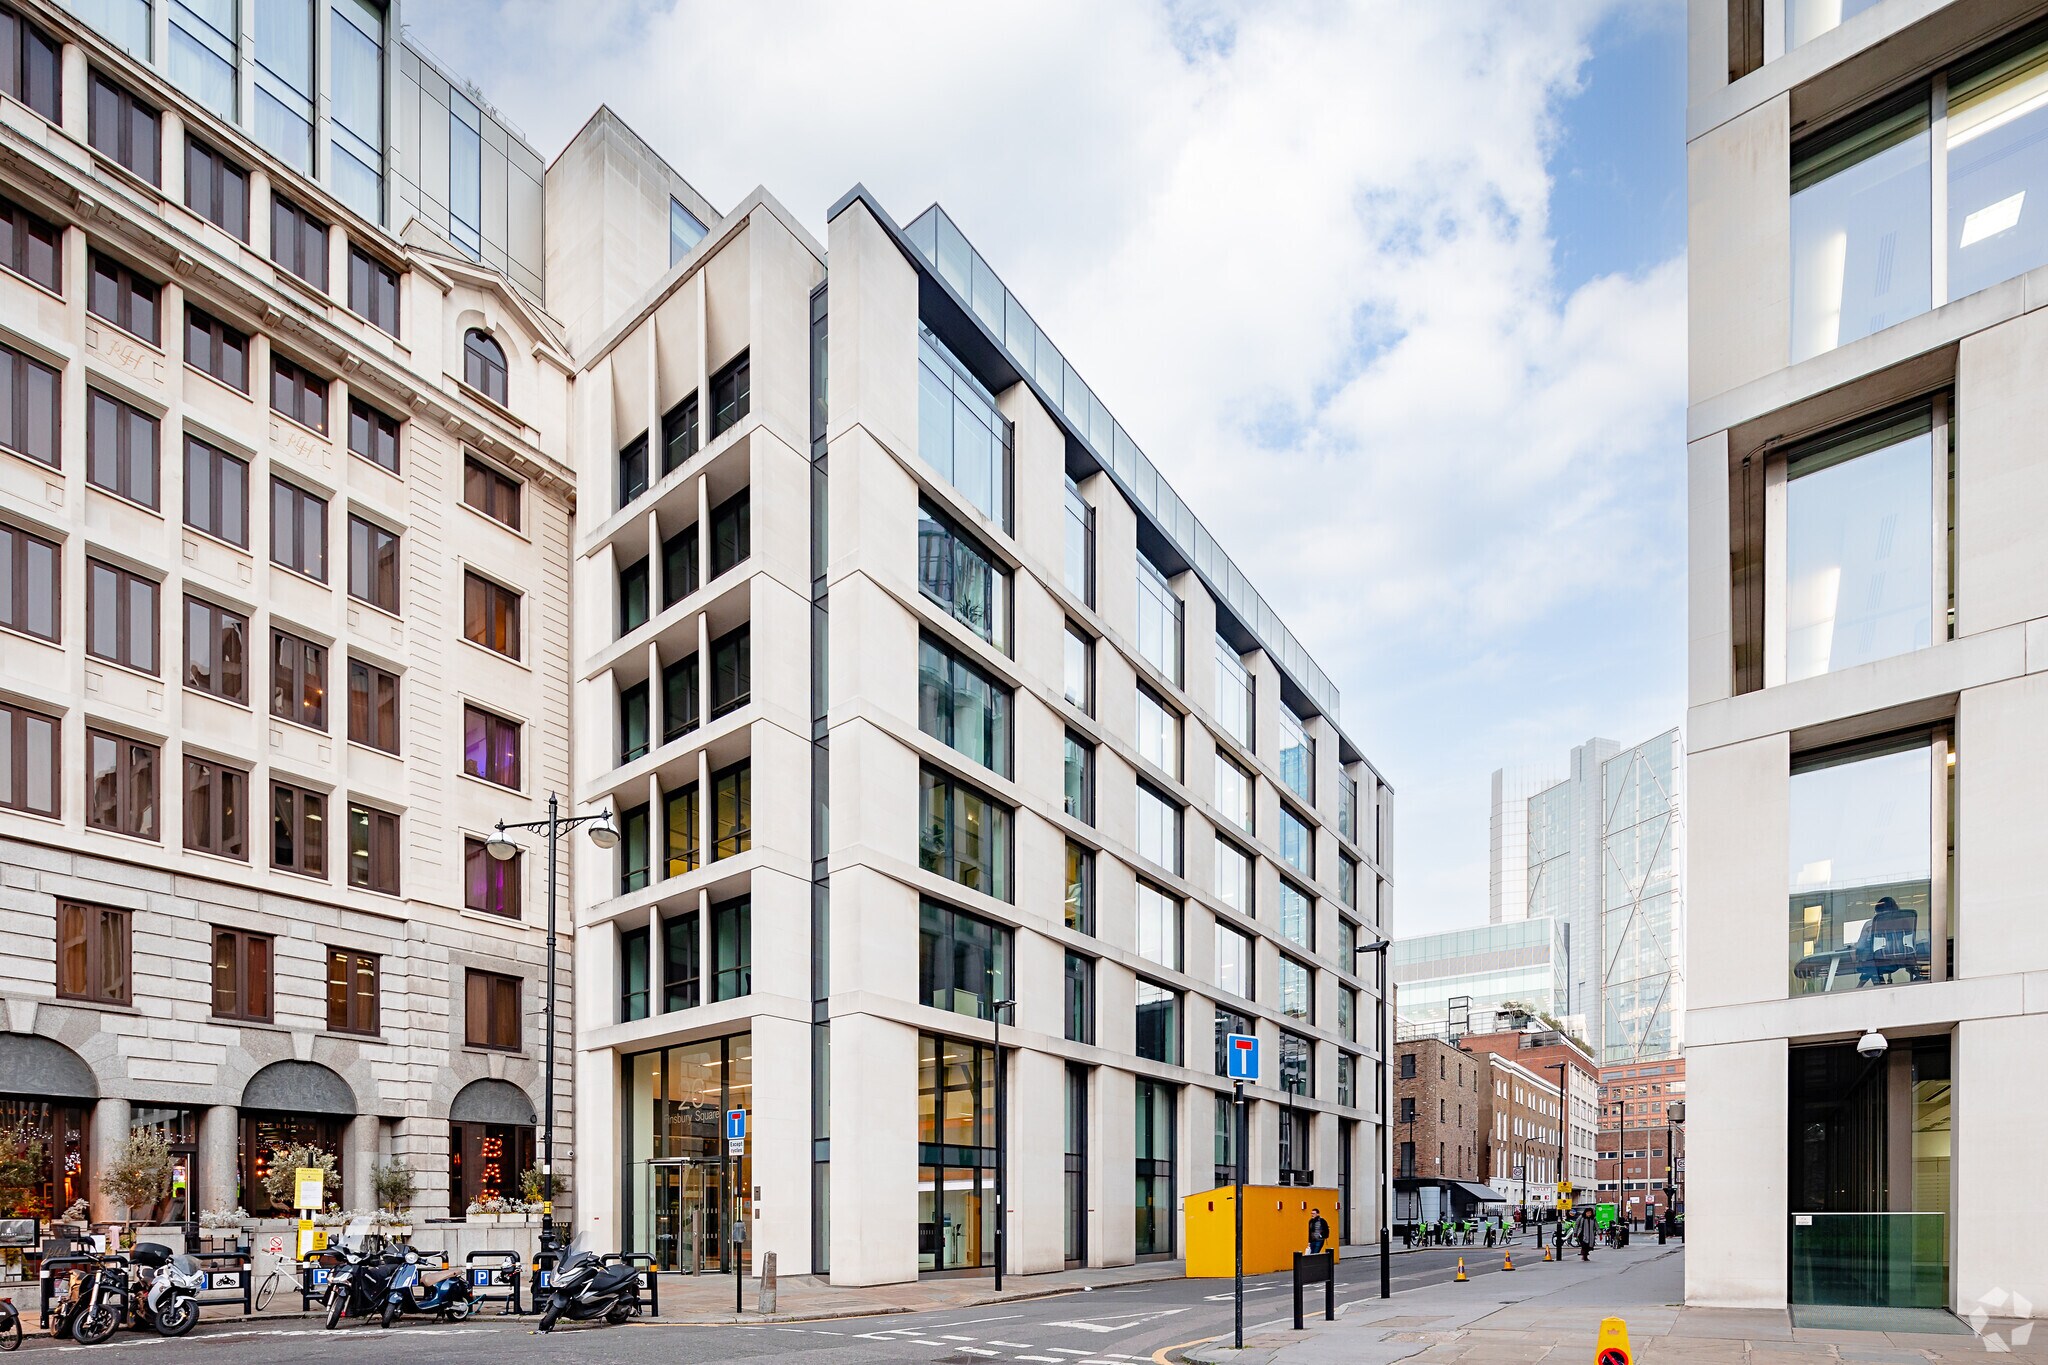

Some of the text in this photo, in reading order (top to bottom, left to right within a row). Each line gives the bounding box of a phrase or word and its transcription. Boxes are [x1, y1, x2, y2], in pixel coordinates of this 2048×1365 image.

[695, 1110, 720, 1124] Square
[317, 1271, 329, 1283] P
[478, 1272, 487, 1283] P
